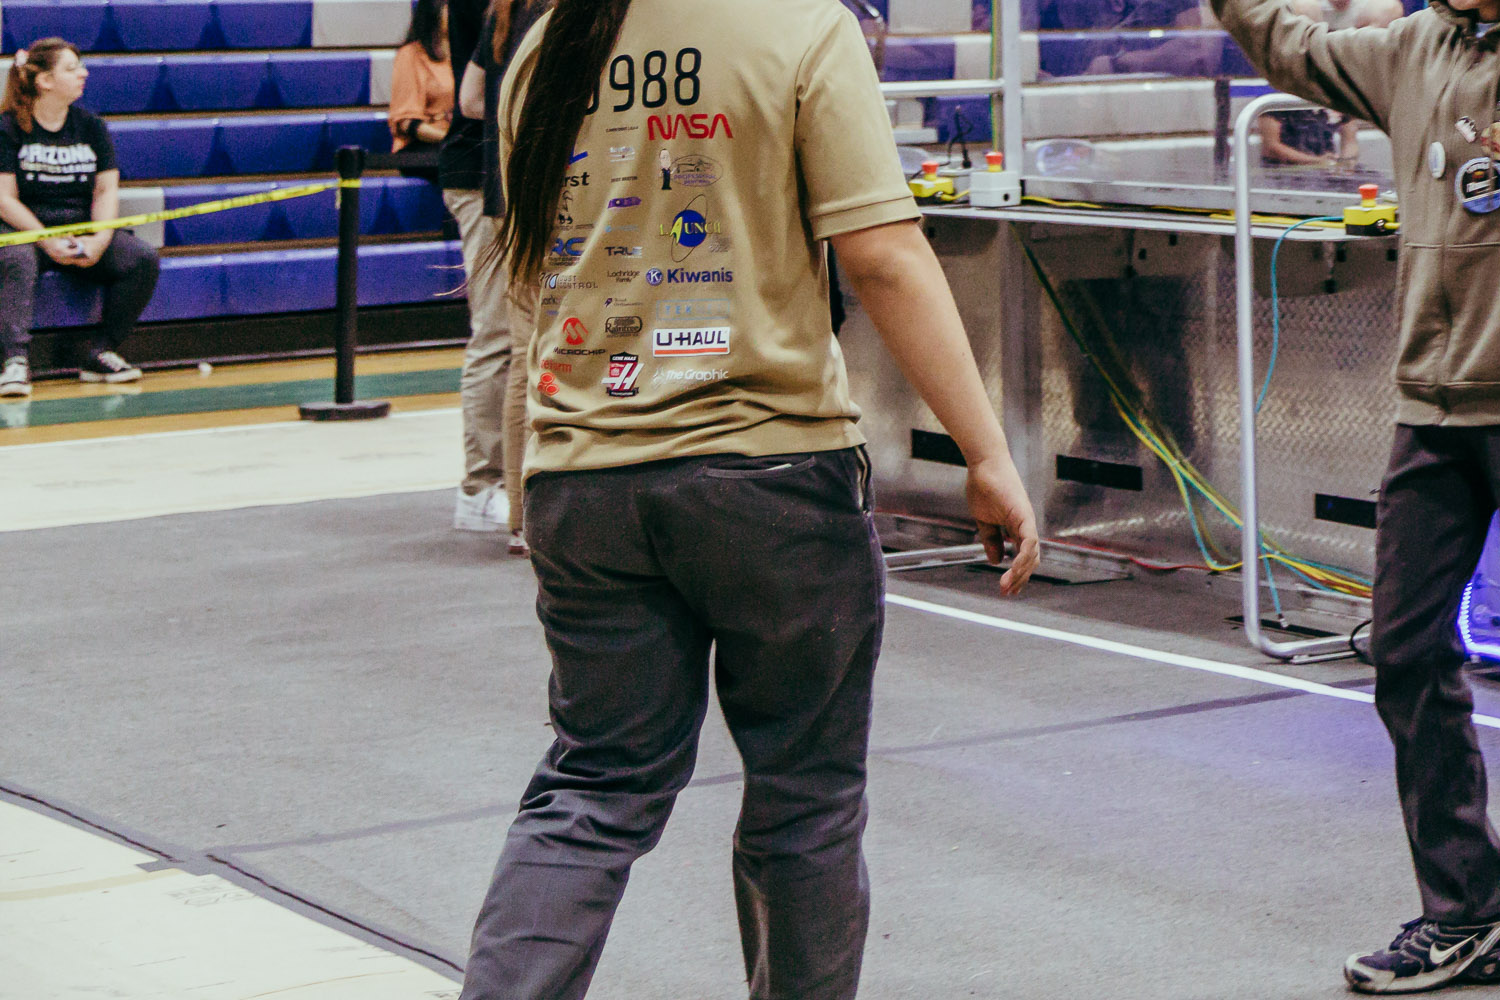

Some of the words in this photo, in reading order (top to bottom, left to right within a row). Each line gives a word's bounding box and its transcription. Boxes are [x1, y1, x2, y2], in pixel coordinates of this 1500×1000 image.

[584, 47, 702, 116] 988
[647, 113, 734, 141] NASA
[562, 171, 590, 188] rst
[667, 267, 734, 283] Kiwanis
[656, 330, 727, 347] U-HAUL
[553, 345, 607, 356] MICROCHIP
[685, 368, 729, 382] Graphic
